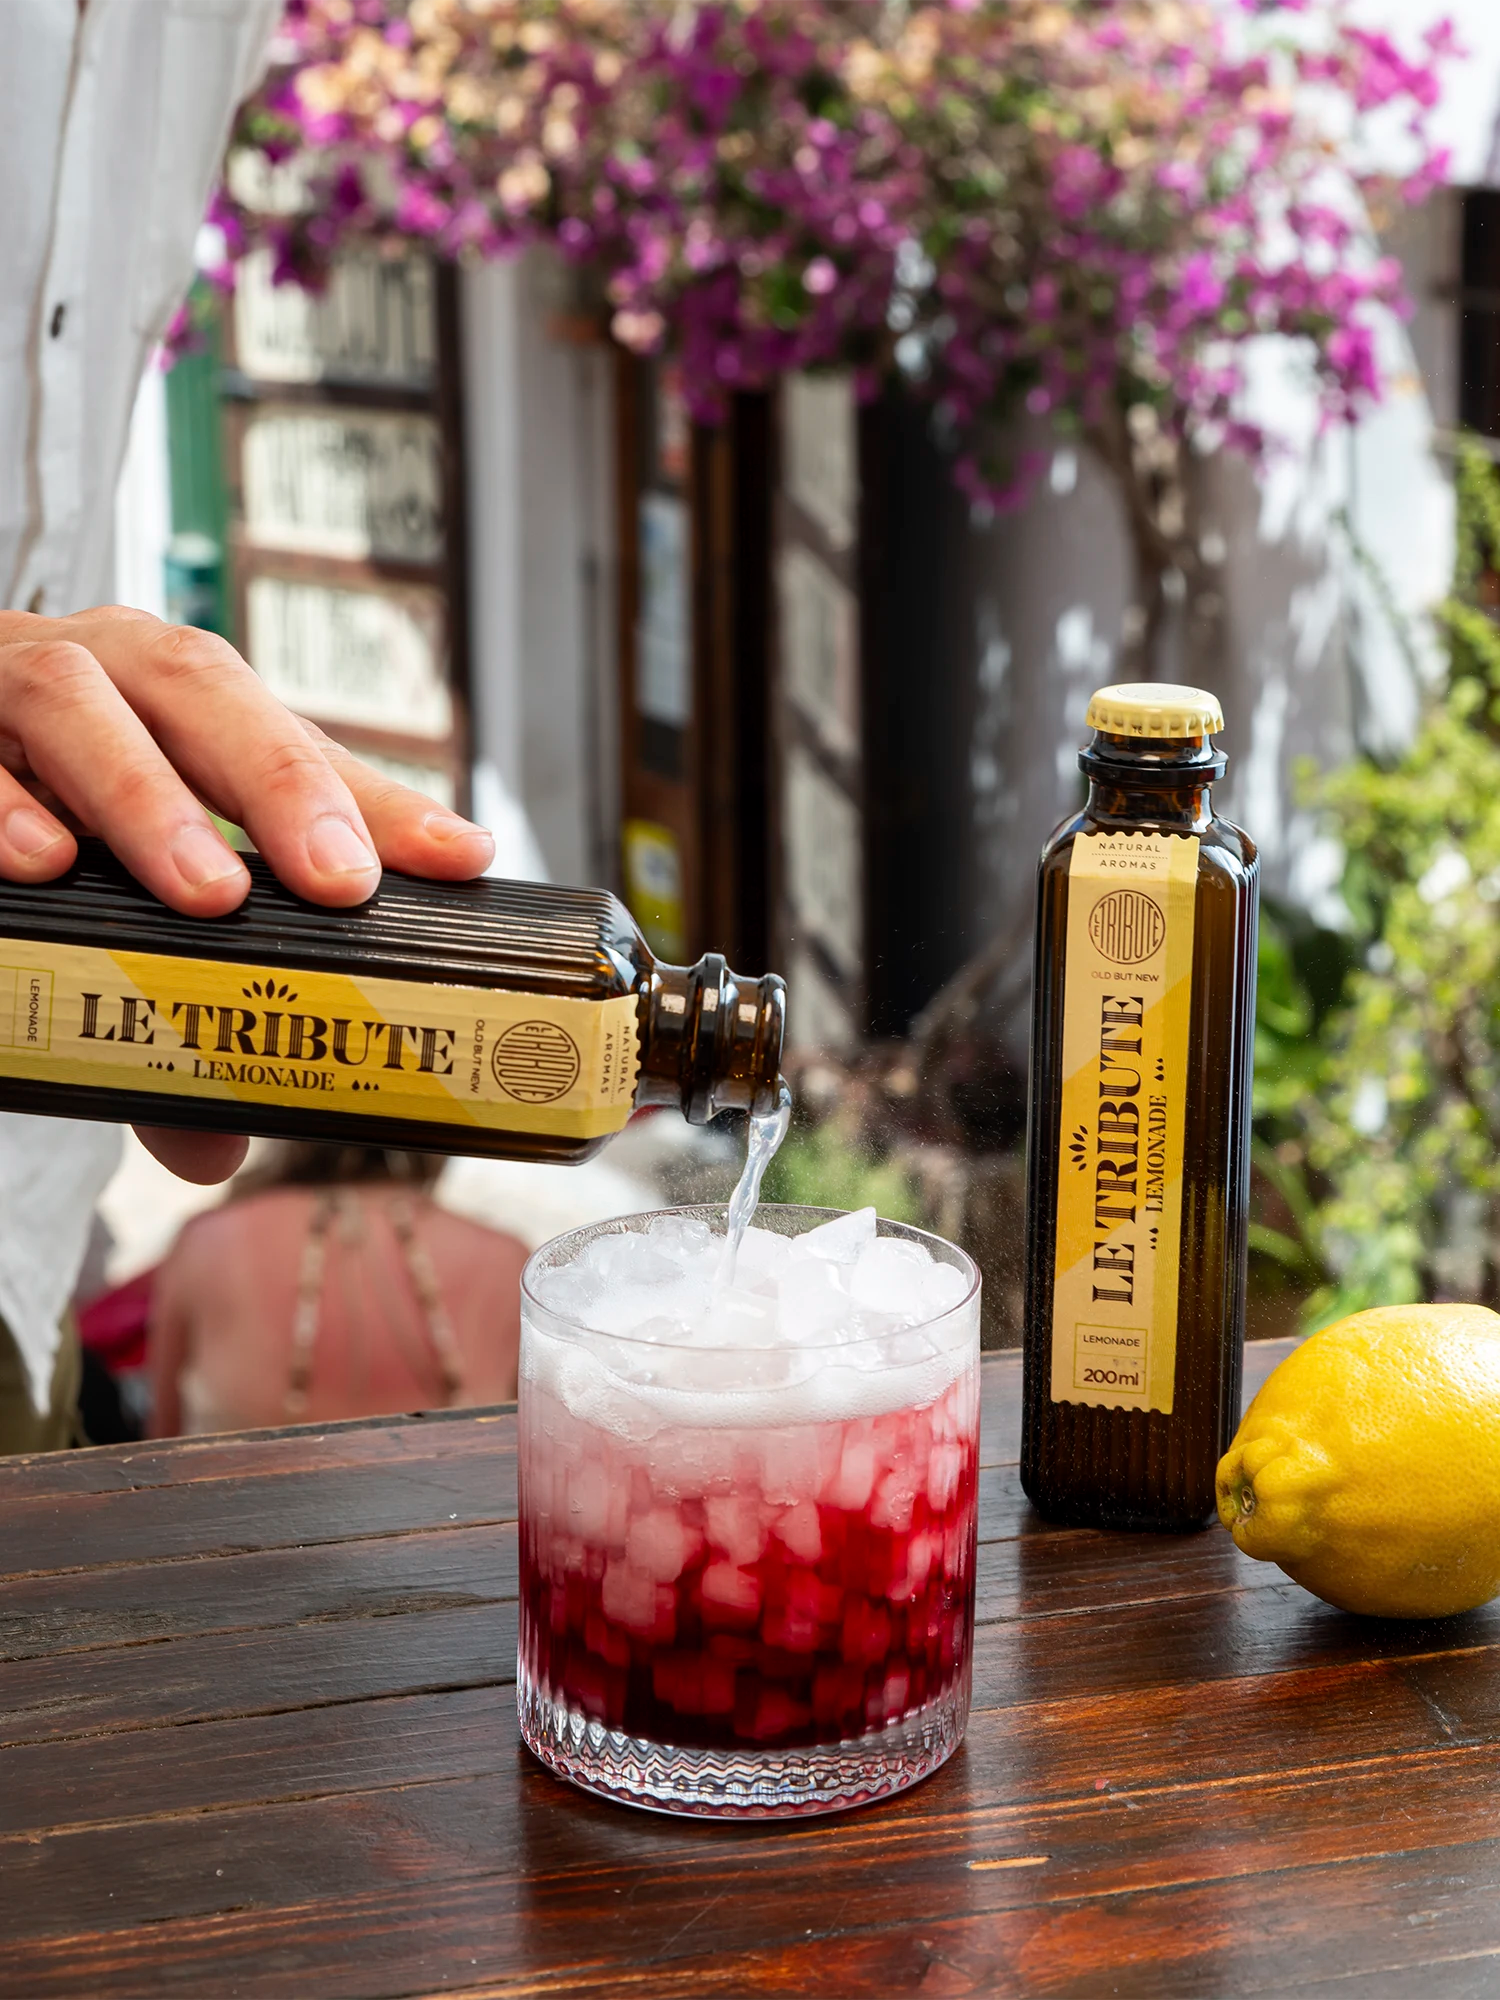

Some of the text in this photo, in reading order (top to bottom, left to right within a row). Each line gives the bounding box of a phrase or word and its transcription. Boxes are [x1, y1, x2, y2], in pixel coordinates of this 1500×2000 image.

[1098, 842, 1161, 853] NATURAL
[1099, 859, 1157, 870] AROMAS
[1100, 894, 1160, 961] TRIBUTE
[1091, 970, 1160, 982] OLD BUT NEW
[27, 978, 40, 1043] LEMONADE
[78, 992, 456, 1075] LE TRIBUTE
[193, 1059, 335, 1091] LEMONADE
[470, 1019, 485, 1094] OLD BUT NEW
[496, 1032, 576, 1099] TRIBUTE
[600, 1032, 613, 1095] AROMAS
[617, 1026, 631, 1094] NATURAL
[1092, 995, 1143, 1306] LE TRIBUTE
[1145, 1096, 1167, 1213] LEMONADE
[1083, 1334, 1140, 1347] LEMONADE
